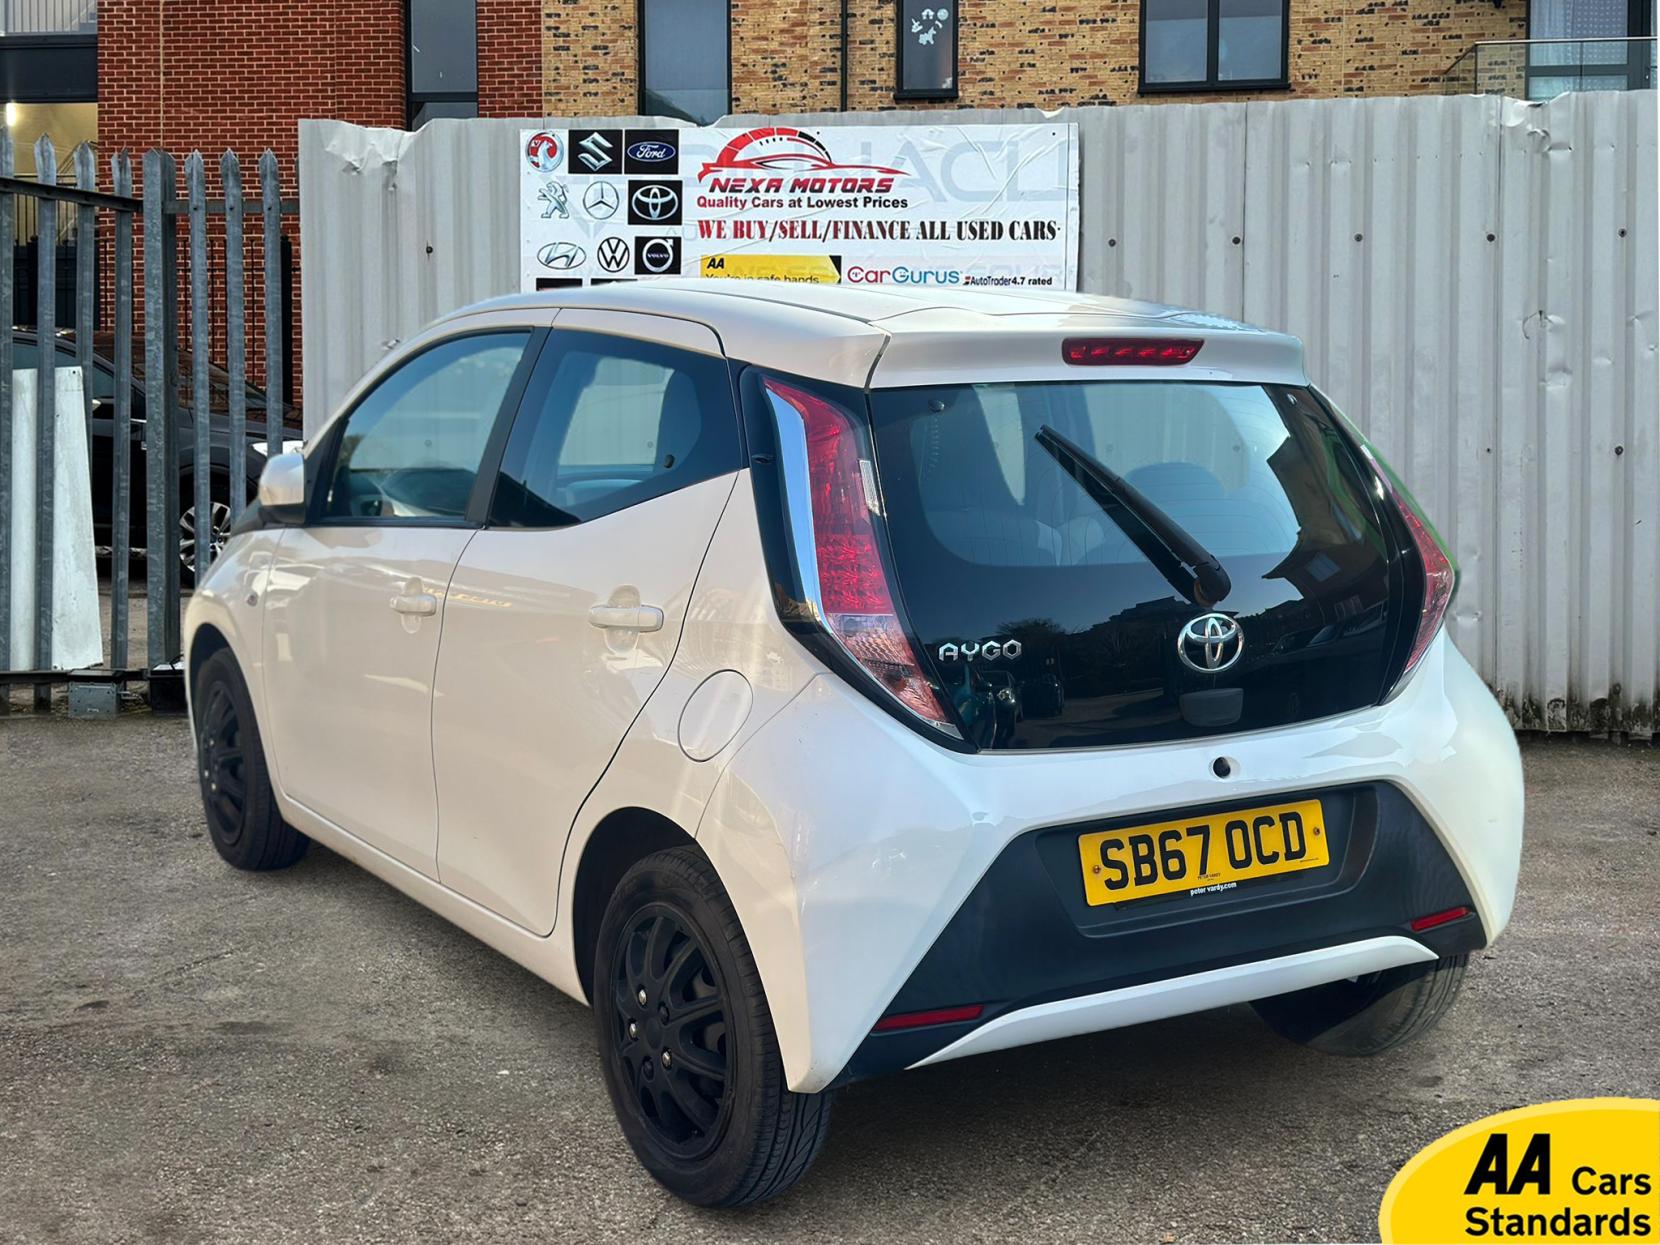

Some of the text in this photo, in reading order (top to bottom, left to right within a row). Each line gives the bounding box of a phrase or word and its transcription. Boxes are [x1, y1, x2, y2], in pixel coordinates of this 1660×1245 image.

[636, 143, 666, 158] Ford
[709, 177, 894, 193] NEXA MOTORS
[697, 195, 908, 210] Quality Cars at Lowest Prices
[698, 219, 726, 239] WE
[916, 220, 950, 240] ALL
[957, 220, 1003, 240] USED
[1009, 220, 1057, 240] CARS
[706, 257, 725, 269] AA
[847, 266, 960, 283] CarGurus
[1028, 277, 1053, 286] rated
[938, 639, 1022, 661] AYGO
[1099, 811, 1307, 891] SB67 OCD
